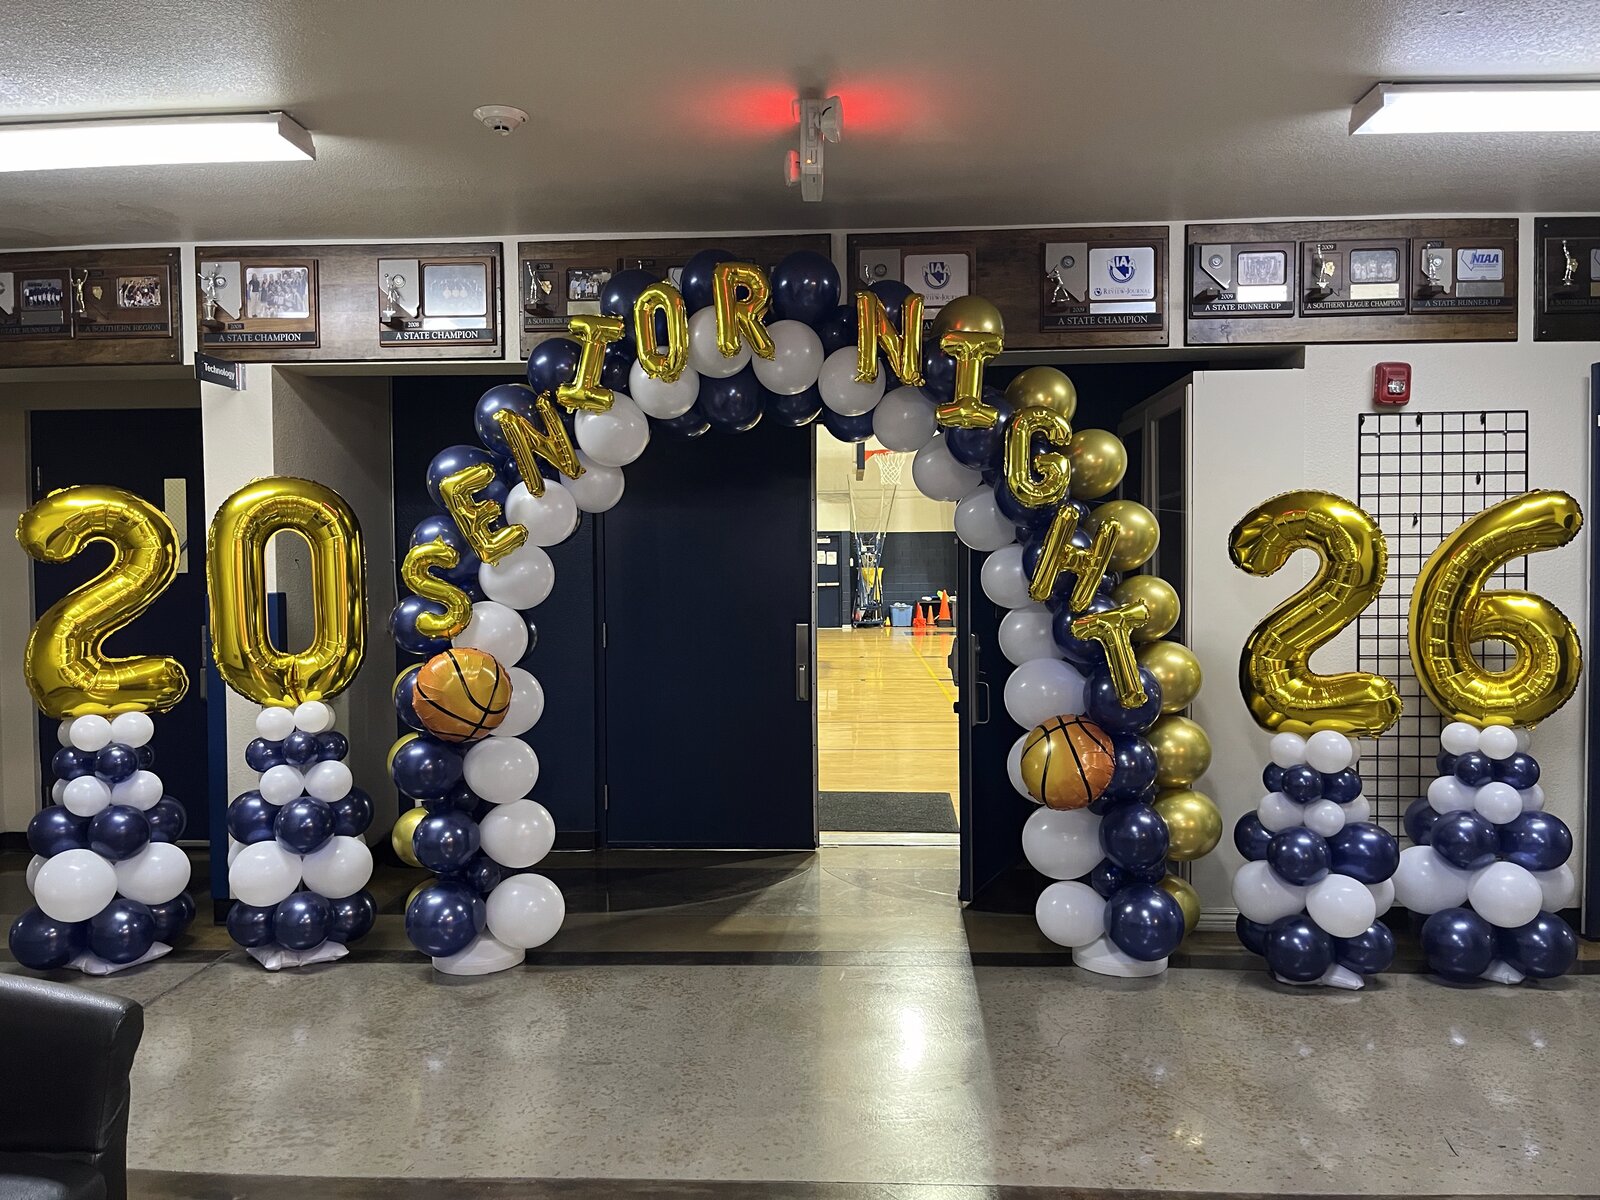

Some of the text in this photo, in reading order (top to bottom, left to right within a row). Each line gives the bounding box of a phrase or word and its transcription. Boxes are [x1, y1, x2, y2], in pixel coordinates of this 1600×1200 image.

[1107, 256, 1136, 270] NIAA
[1472, 254, 1499, 264] NIAA
[922, 262, 951, 276] NIAA
[533, 317, 563, 325] SOUTHERN
[1058, 315, 1148, 325] A STATE CHAMPION
[133, 324, 161, 332] REGION
[219, 333, 302, 342] A STATE CHAMPION
[396, 330, 479, 340] A STATE CHAMPION
[203, 362, 236, 380] Technology
[401, 262, 1152, 709] SENIOR NIGHT
